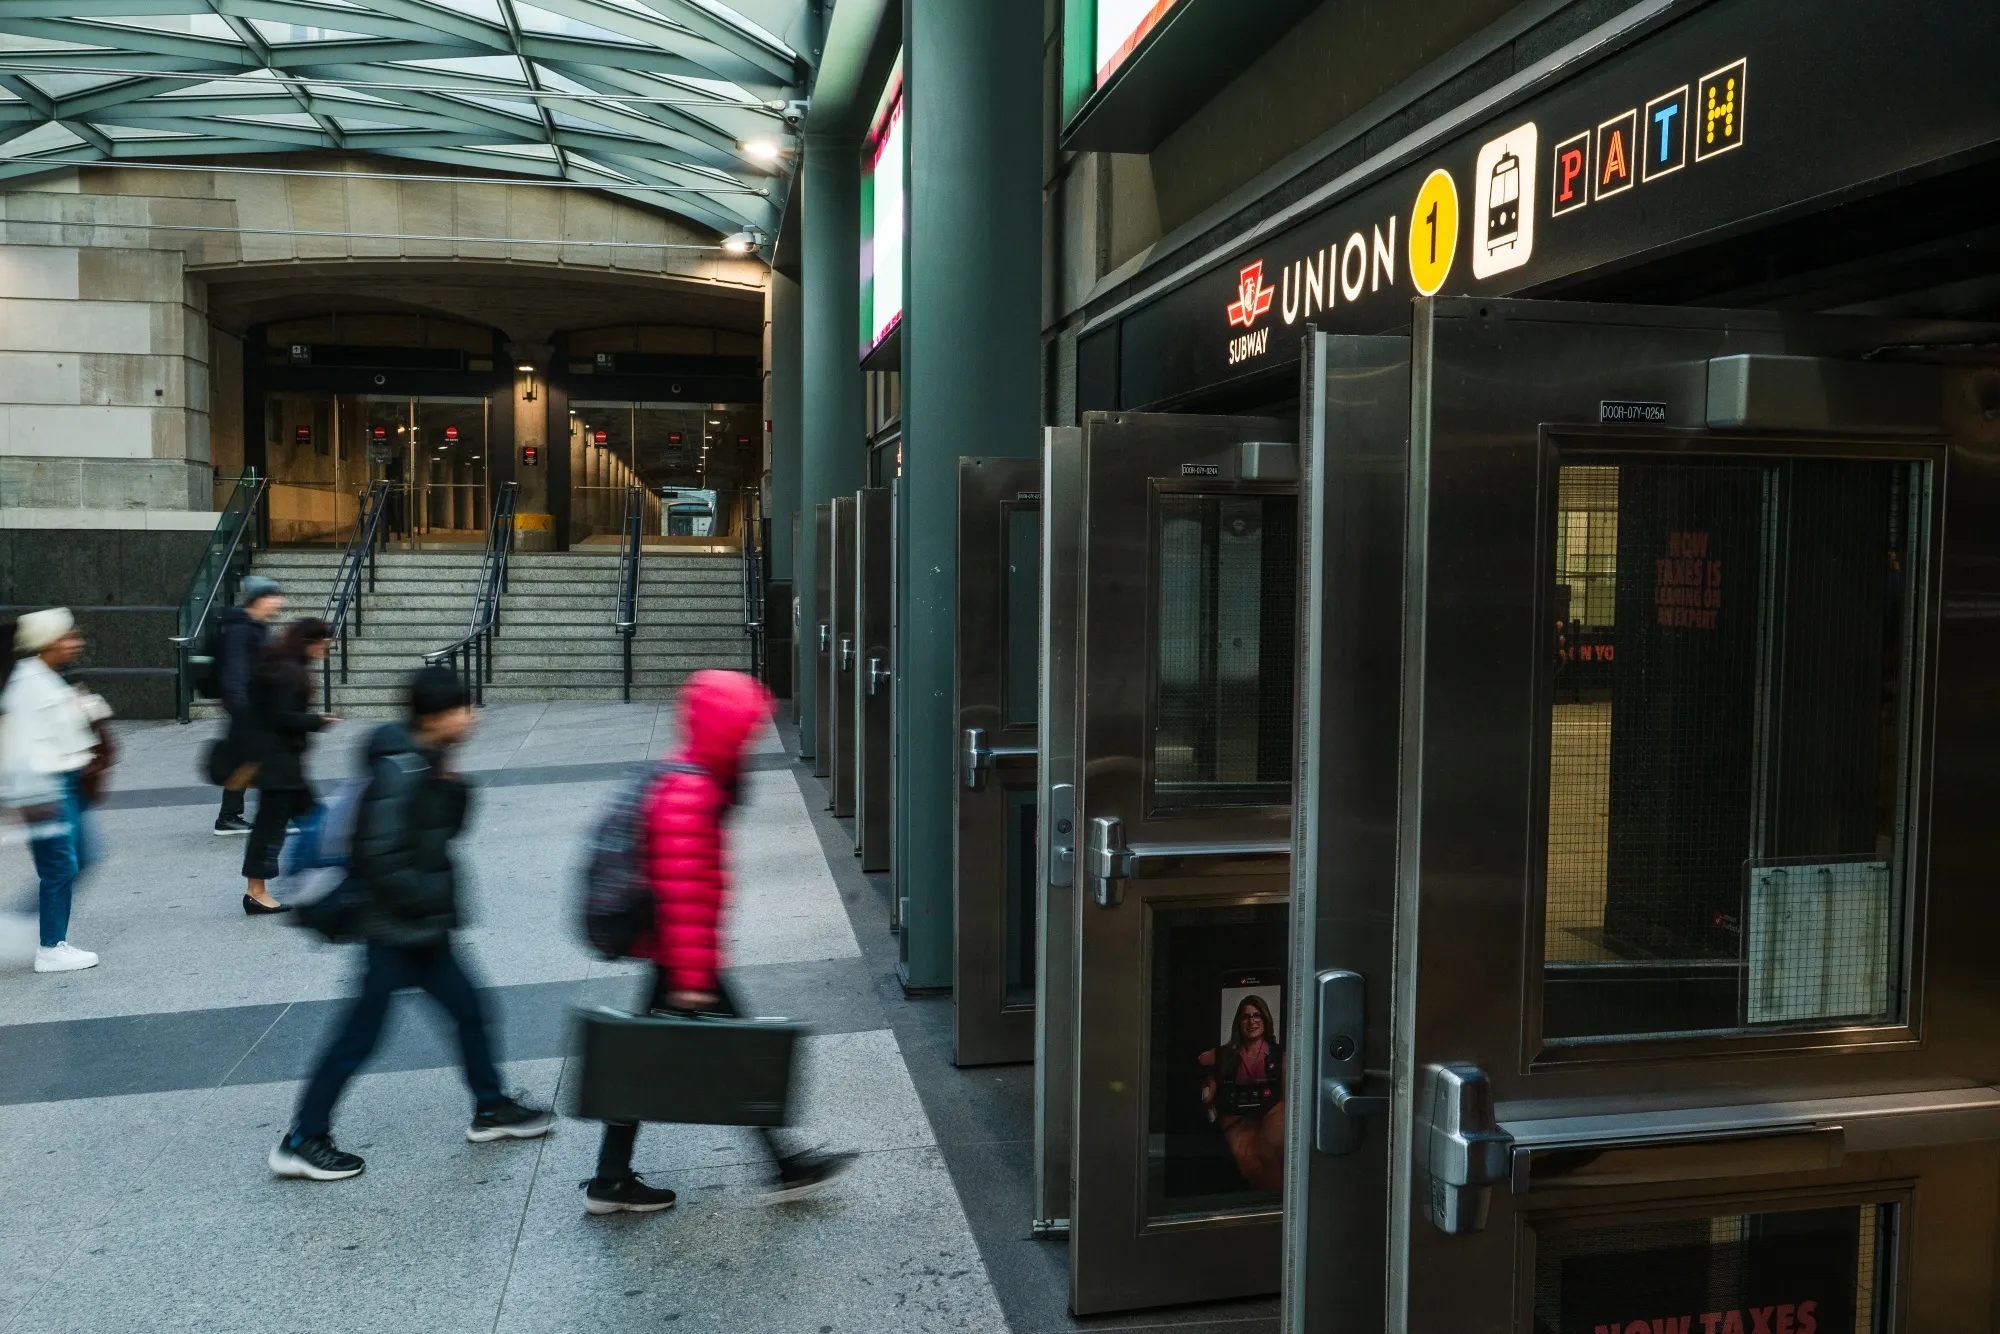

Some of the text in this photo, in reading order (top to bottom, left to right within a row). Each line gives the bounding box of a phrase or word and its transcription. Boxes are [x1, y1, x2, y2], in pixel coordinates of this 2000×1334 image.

[1282, 77, 1736, 325] UNION 1 PATH
[1228, 326, 1269, 366] SUBWAY
[1602, 405, 1665, 420] DOOR-07Y-025A
[1700, 1300, 1818, 1334] TAXES
